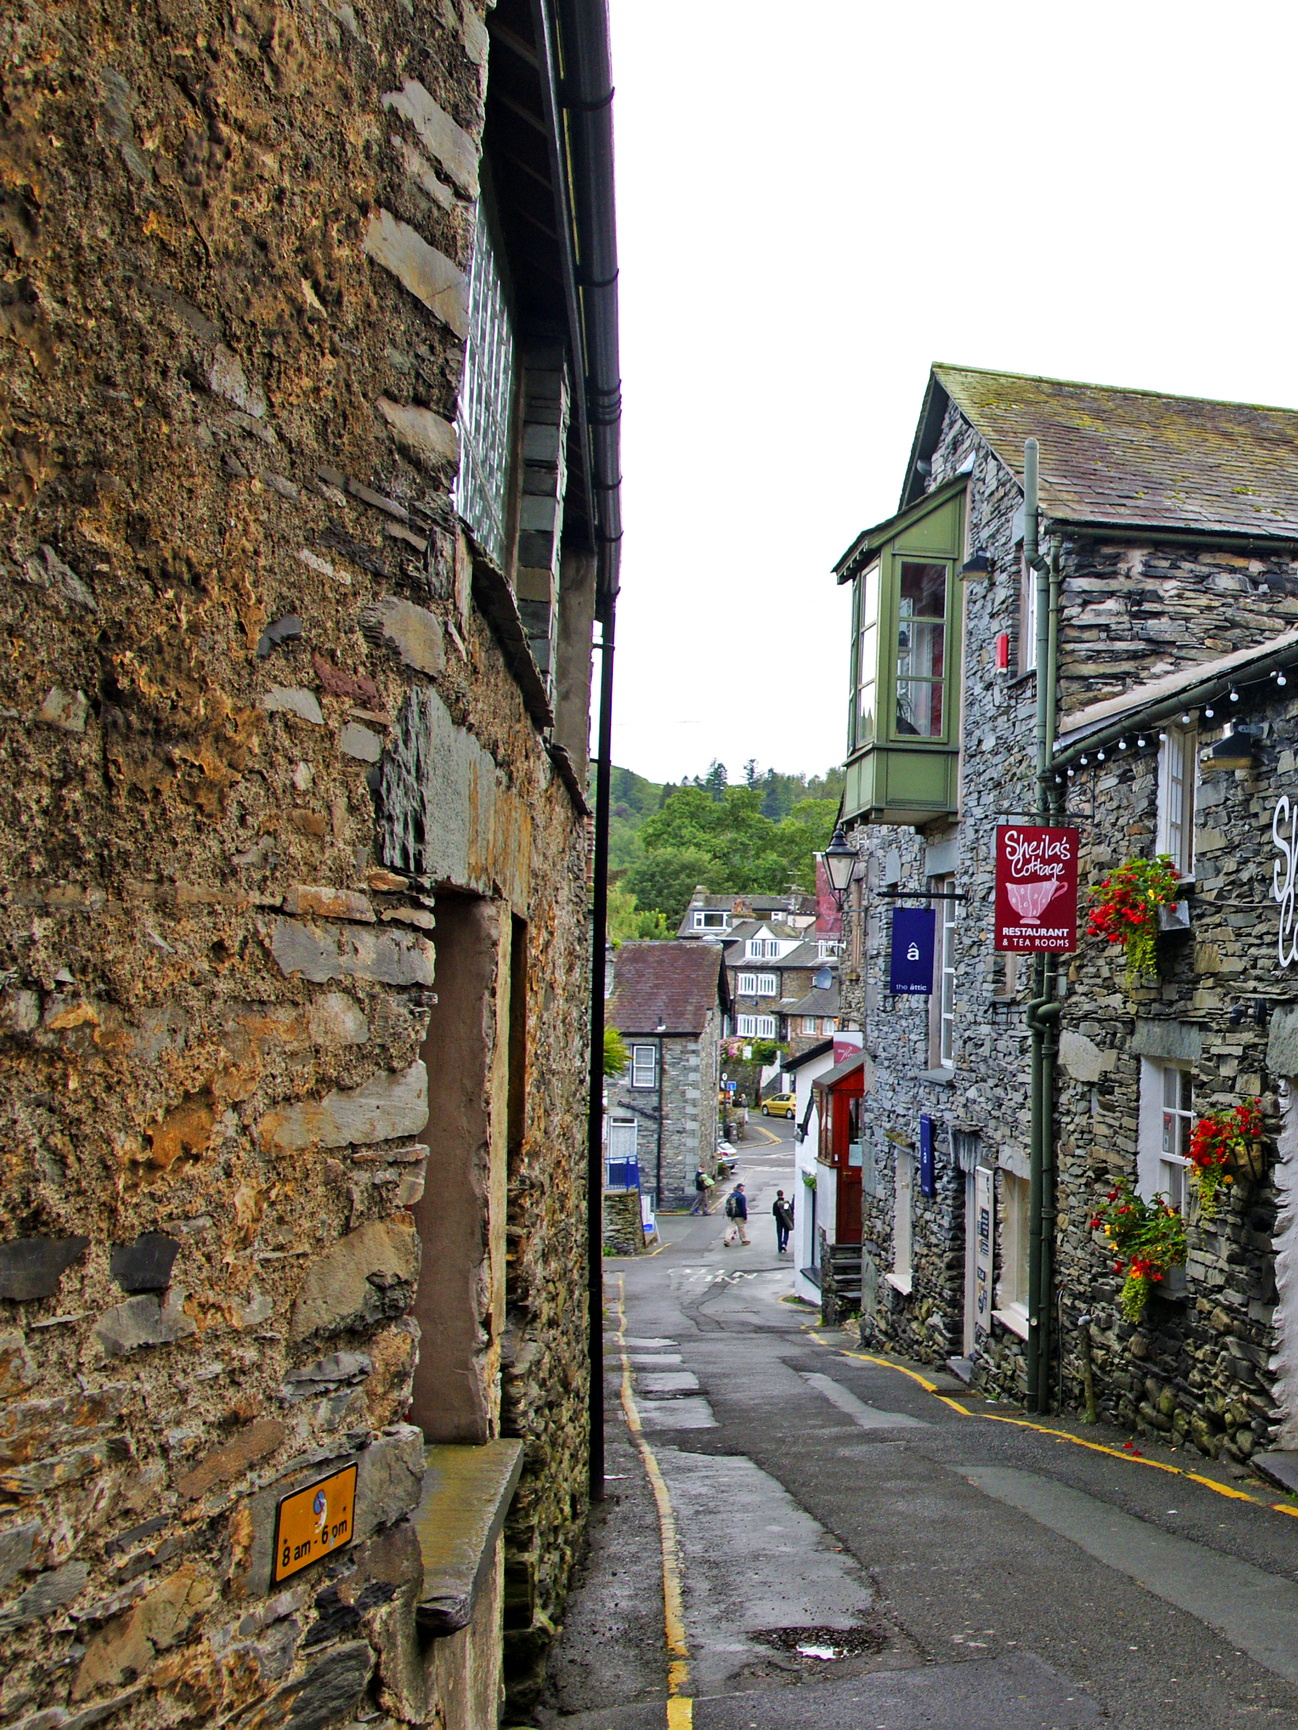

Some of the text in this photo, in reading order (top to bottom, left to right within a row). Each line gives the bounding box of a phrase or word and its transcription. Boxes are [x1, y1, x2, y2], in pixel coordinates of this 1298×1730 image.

[1004, 830, 1071, 860] Sheila's
[1011, 856, 1065, 881] Cottage
[1002, 927, 1069, 937] RESTAURANT
[1002, 938, 1009, 946] &
[1035, 939, 1070, 947] ROOMS
[282, 1545, 291, 1567] 8
[294, 1540, 311, 1561] am
[321, 1525, 329, 1545] 6
